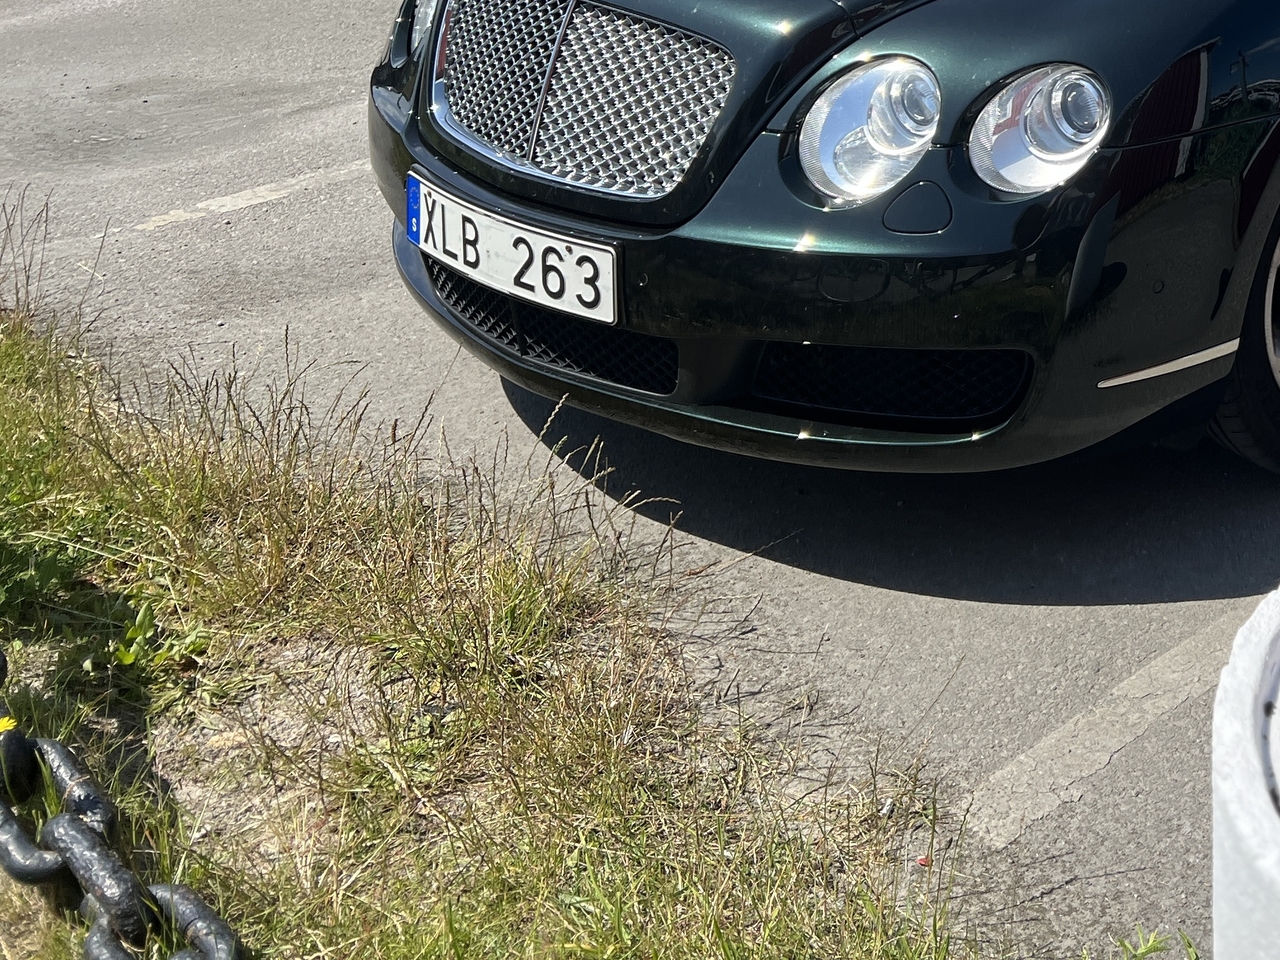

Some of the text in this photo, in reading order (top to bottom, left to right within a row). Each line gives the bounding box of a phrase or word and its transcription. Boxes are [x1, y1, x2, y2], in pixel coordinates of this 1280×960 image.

[411, 216, 418, 233] S
[423, 192, 601, 310] XLB 263
